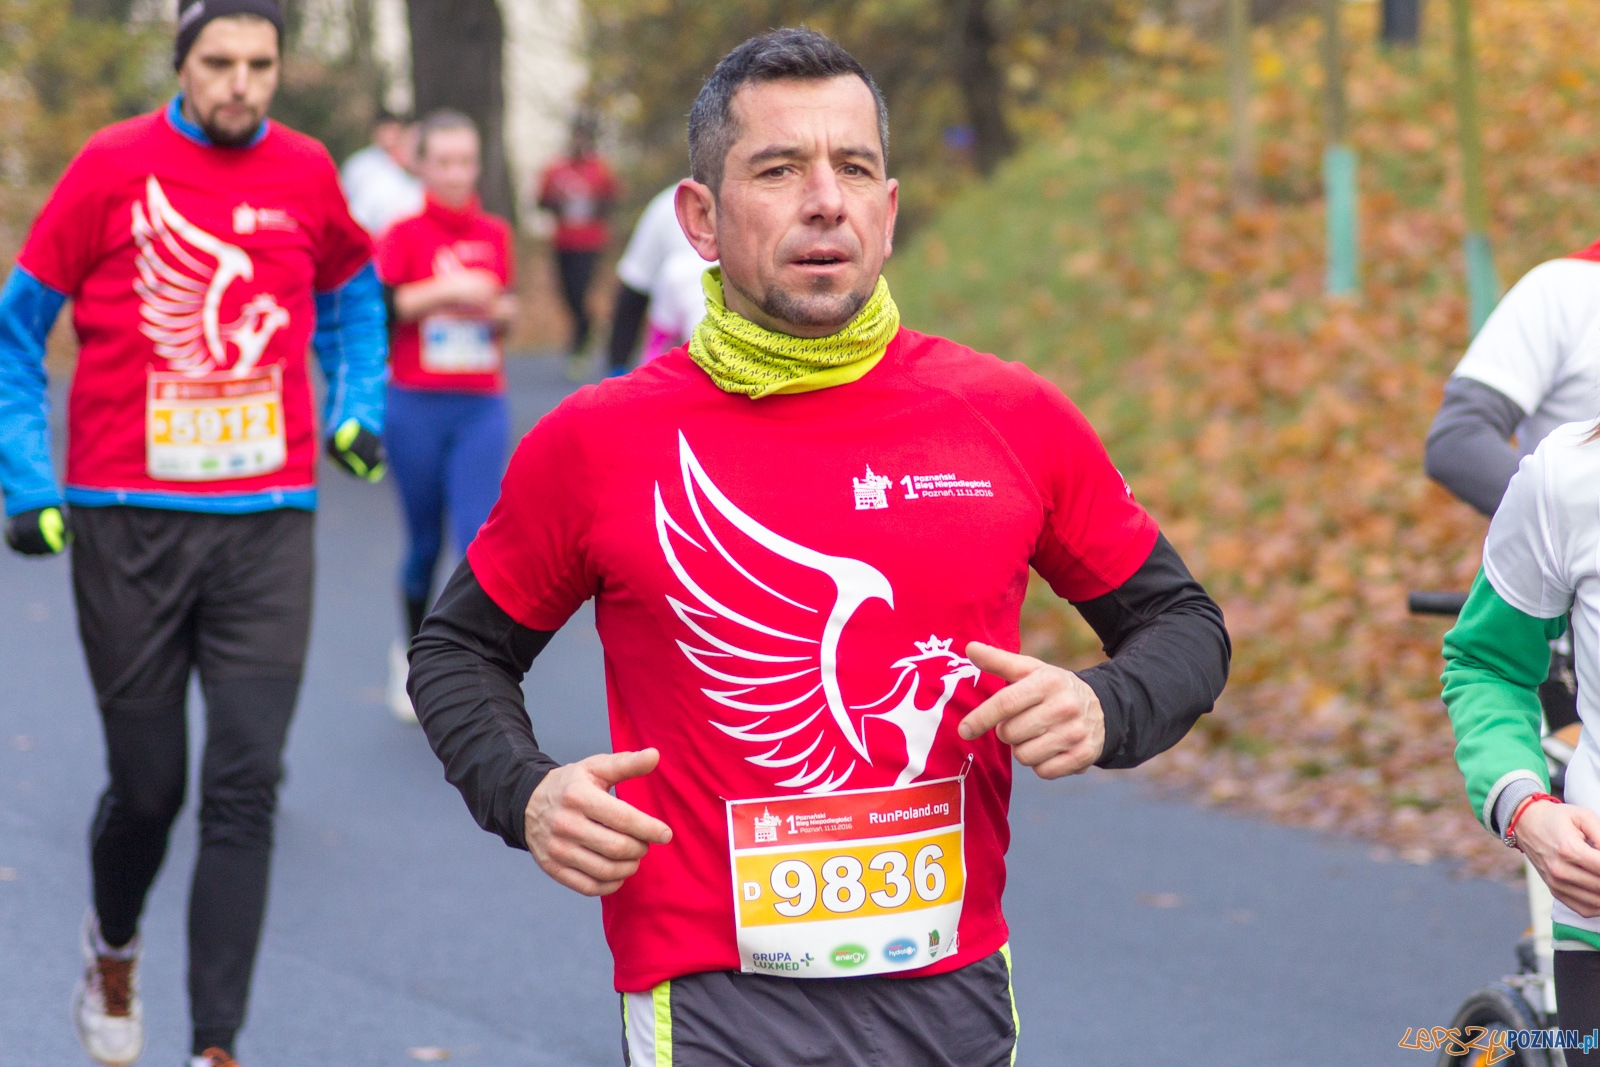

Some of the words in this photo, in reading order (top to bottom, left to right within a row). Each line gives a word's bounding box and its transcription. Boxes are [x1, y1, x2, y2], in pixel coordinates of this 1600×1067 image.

[171, 404, 270, 443] 5912
[914, 473, 956, 482] Poznański
[900, 475, 919, 499] 1
[956, 489, 994, 497] 11.11.2016
[869, 803, 949, 824] RunPoland.org
[786, 815, 798, 834] 1
[743, 882, 761, 901] D
[770, 844, 946, 917] 9836
[752, 952, 792, 962] GRUPA
[835, 952, 865, 963] energy
[753, 960, 800, 971] LUXMED
